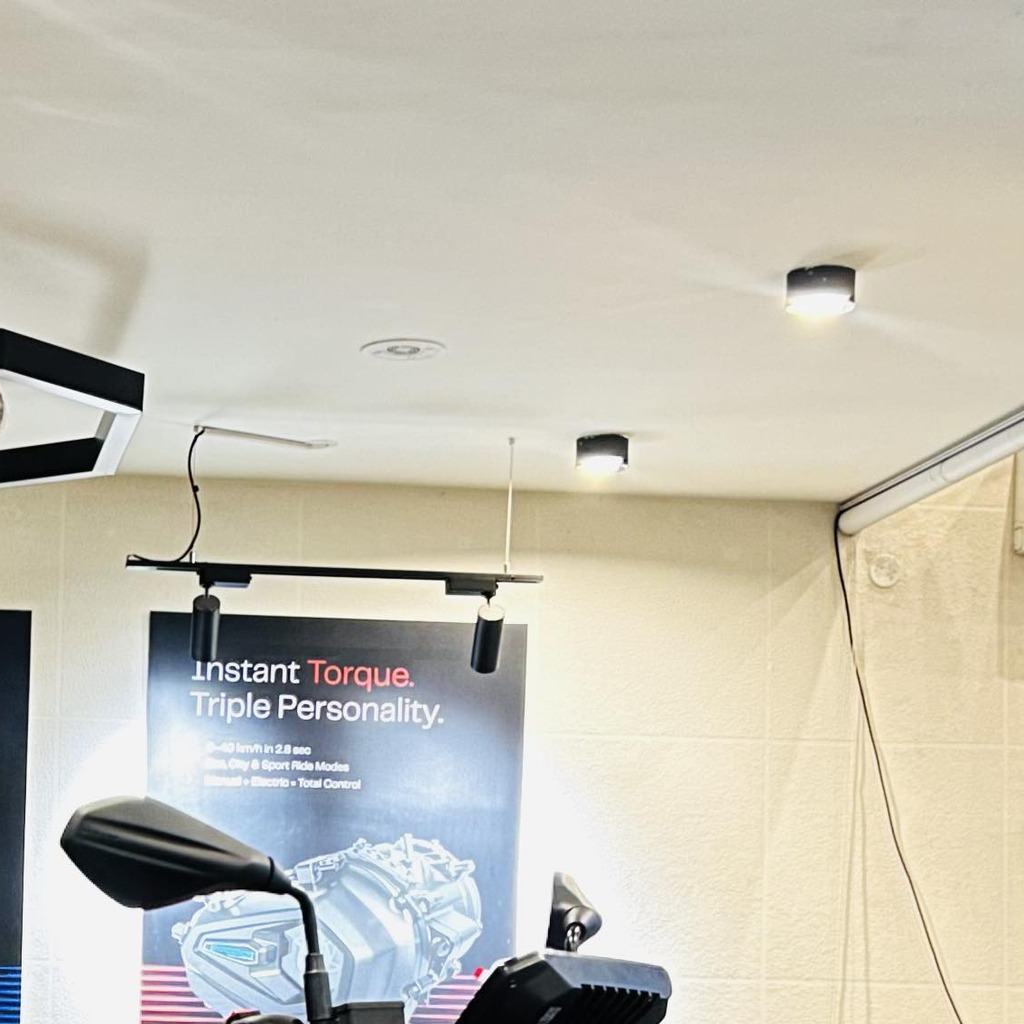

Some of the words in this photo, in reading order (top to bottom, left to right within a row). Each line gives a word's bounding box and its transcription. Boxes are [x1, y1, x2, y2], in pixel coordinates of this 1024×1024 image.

[191, 658, 300, 685] Instant
[307, 659, 415, 692] Torque.
[189, 690, 271, 724] Triple
[278, 693, 445, 729] Personality.
[261, 760, 290, 772] Sport
[291, 760, 314, 771] Ride
[315, 761, 350, 773] Modes
[297, 777, 322, 789] Total
[323, 778, 362, 790] Control
